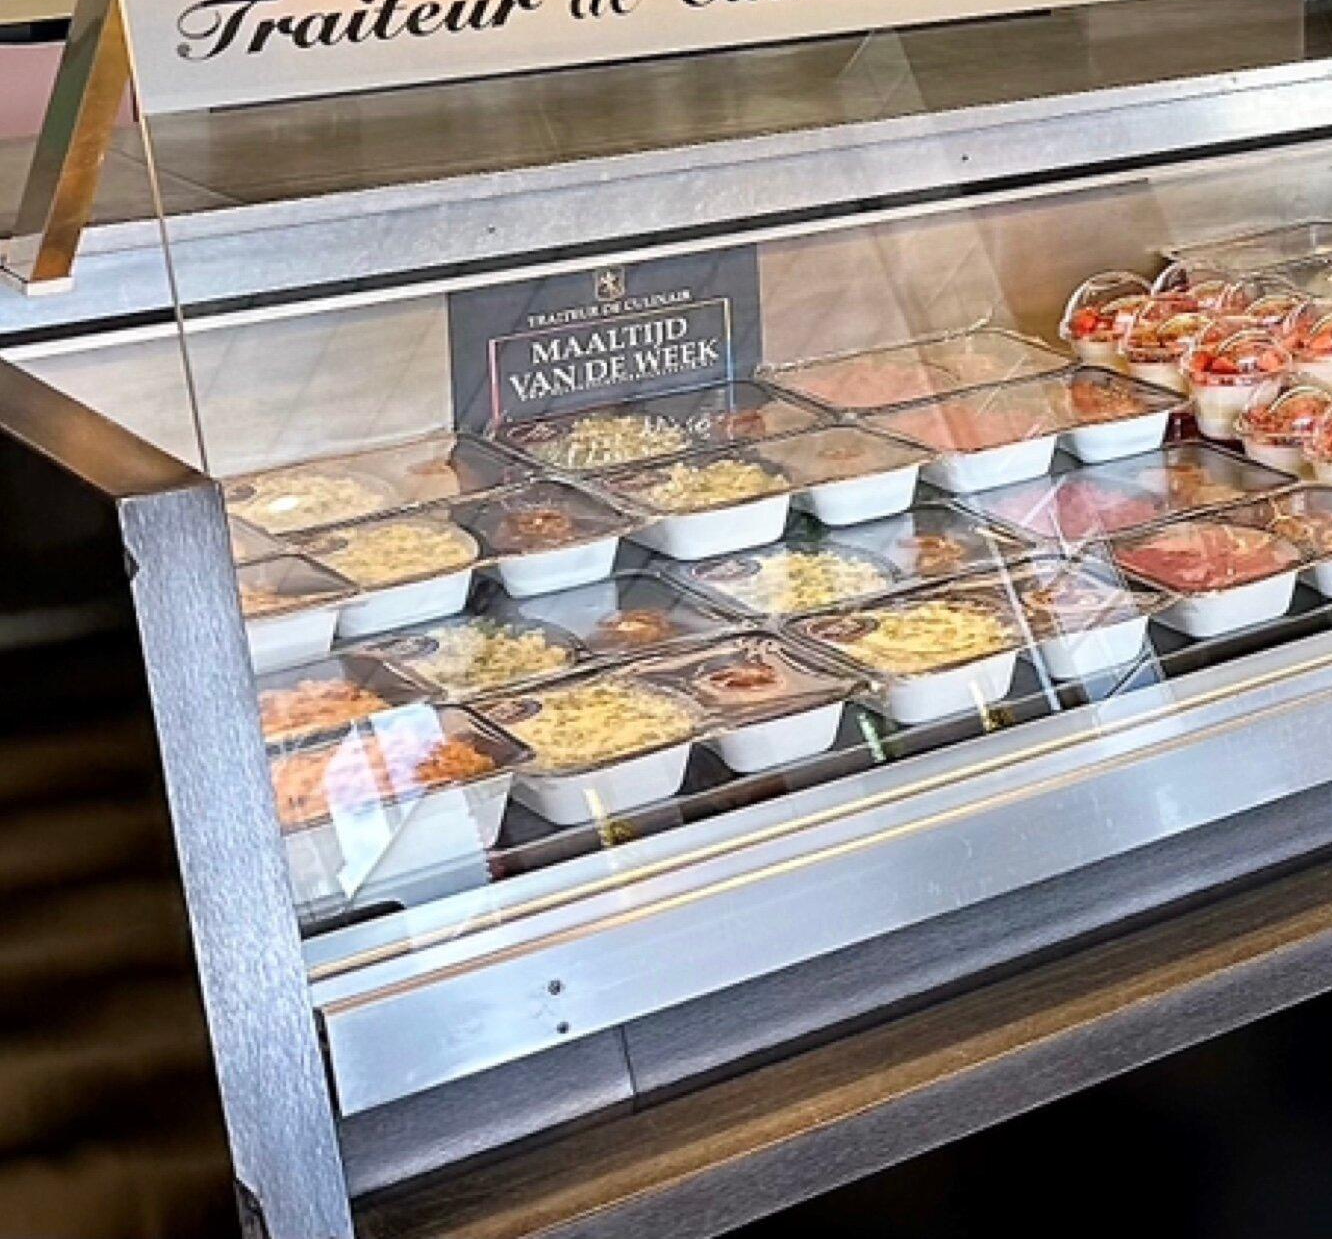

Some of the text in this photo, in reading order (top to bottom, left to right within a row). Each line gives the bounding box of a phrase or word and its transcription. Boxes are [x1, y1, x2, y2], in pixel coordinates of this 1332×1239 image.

[530, 316, 688, 366] MAALTIJD
[509, 338, 720, 402] VAN DE WEEK
